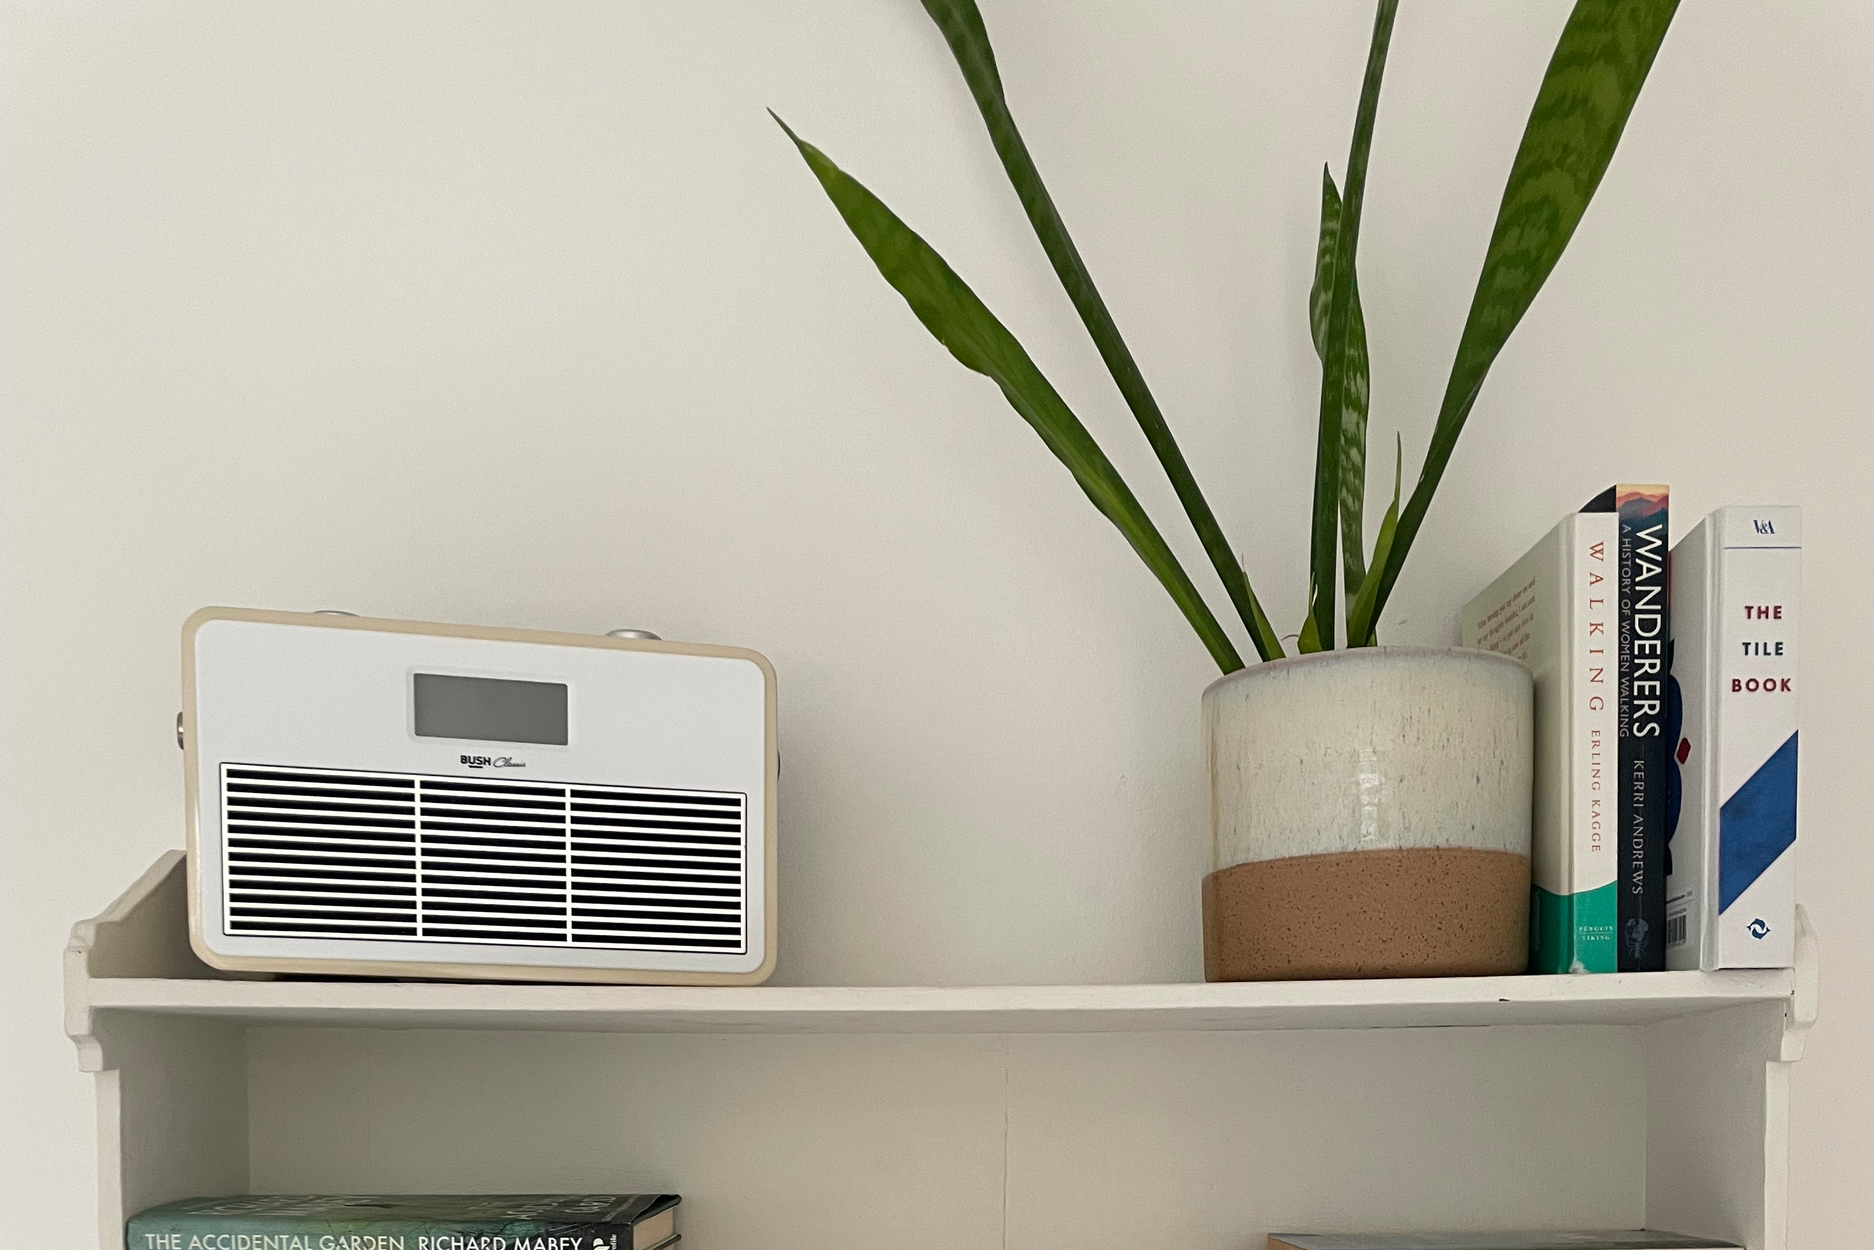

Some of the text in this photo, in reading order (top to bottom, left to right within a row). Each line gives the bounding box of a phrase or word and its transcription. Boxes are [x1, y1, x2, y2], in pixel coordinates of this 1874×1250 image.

[1753, 519, 1775, 534] V&A
[1744, 606, 1783, 620] THE
[1589, 541, 1604, 711] WALKING
[1633, 524, 1663, 738] WANDERERS
[1619, 538, 1632, 738] HISTORY OF WOMEN WALKING
[1742, 642, 1784, 656] TILE
[1731, 678, 1792, 692] BOOK
[460, 755, 491, 767] BUSH
[1591, 730, 1601, 853] ERLING KAGGE
[1631, 760, 1645, 895] KERRI ANDREWS
[145, 1234, 181, 1250] THE
